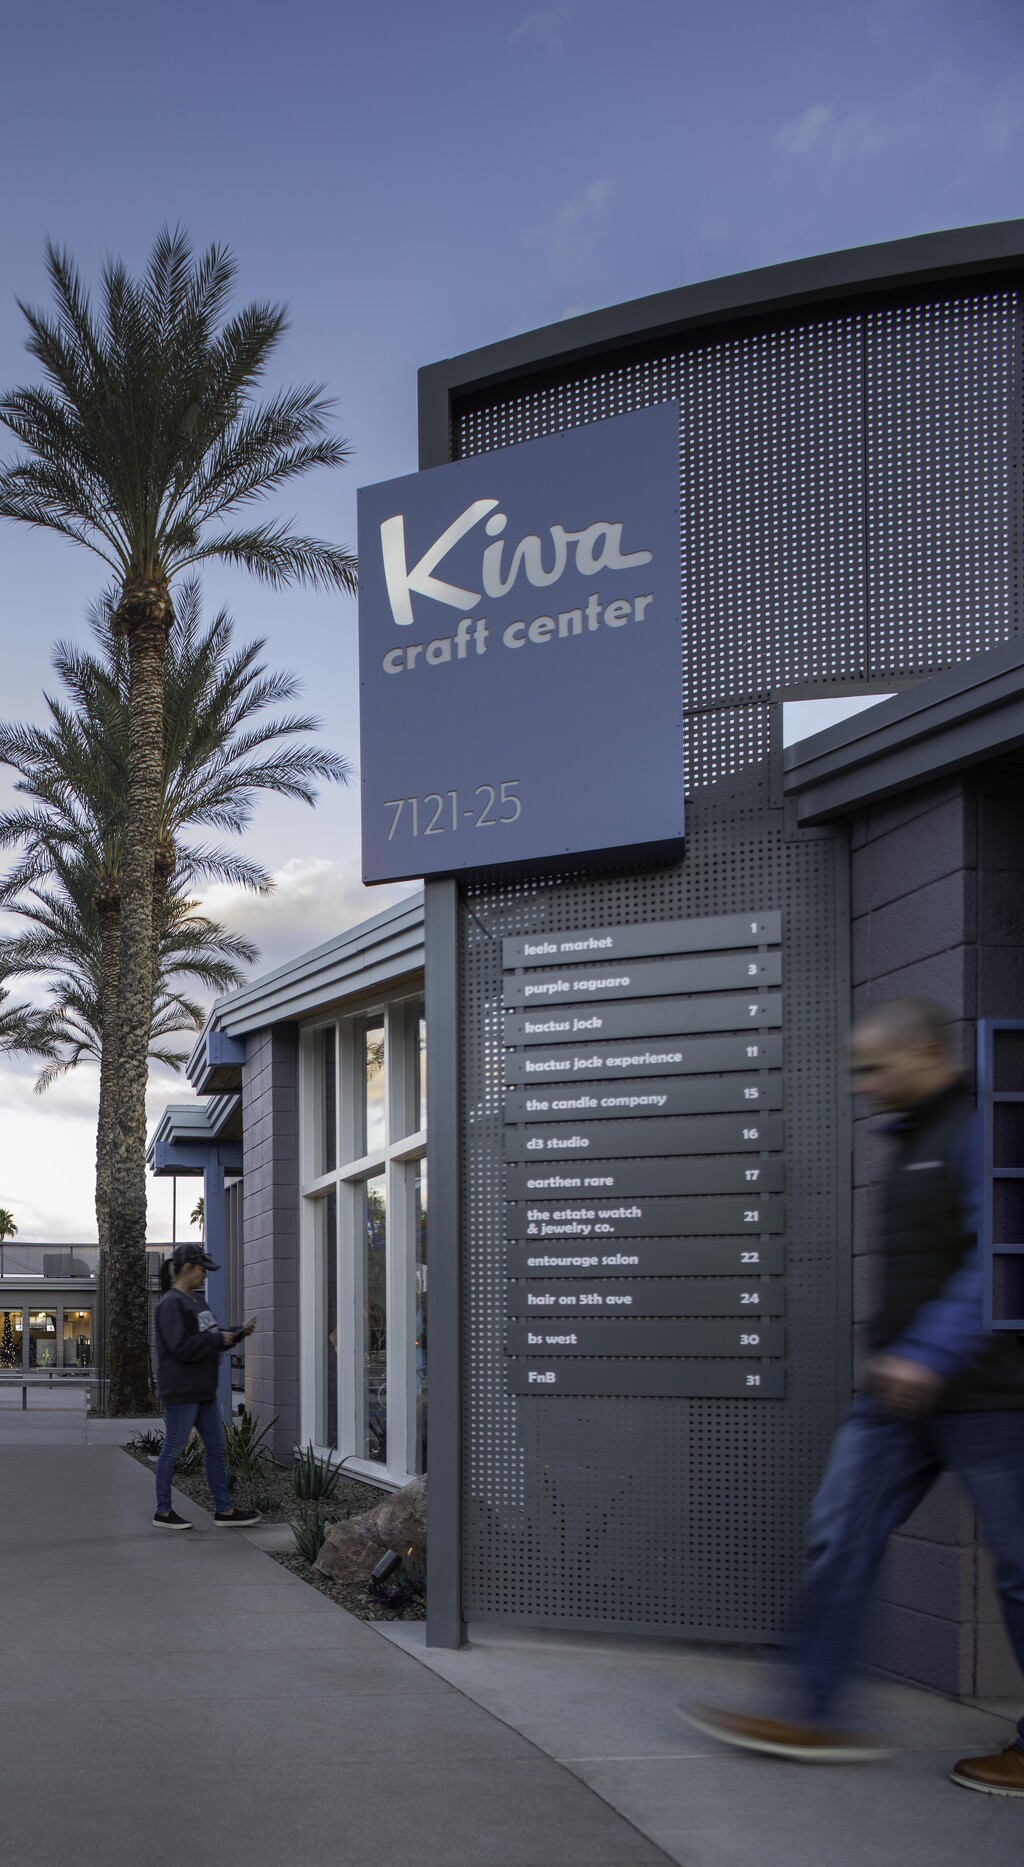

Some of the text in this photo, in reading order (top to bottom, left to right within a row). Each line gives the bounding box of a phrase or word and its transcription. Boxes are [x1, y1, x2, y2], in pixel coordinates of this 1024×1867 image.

[380, 498, 653, 626] Kiva
[382, 591, 654, 674] craft center
[384, 780, 522, 841] 7121-25
[524, 922, 758, 956] leela market 1
[524, 963, 758, 997] purple saguaro 3
[524, 1004, 759, 1034] kactus jock 7
[525, 1045, 759, 1073] kactus jock experience 11
[525, 1087, 759, 1111] the candle company 15
[526, 1128, 759, 1150] d3 studio 16
[526, 1169, 760, 1189] earthen rare 17
[526, 1205, 759, 1222] the estate watch 21
[526, 1221, 615, 1236] & jewelry co.
[527, 1251, 760, 1268] entourage salon 22
[527, 1292, 760, 1305] hair on 5th ave 24
[527, 1332, 760, 1345] bs west 30
[528, 1371, 761, 1386] FnB 31
